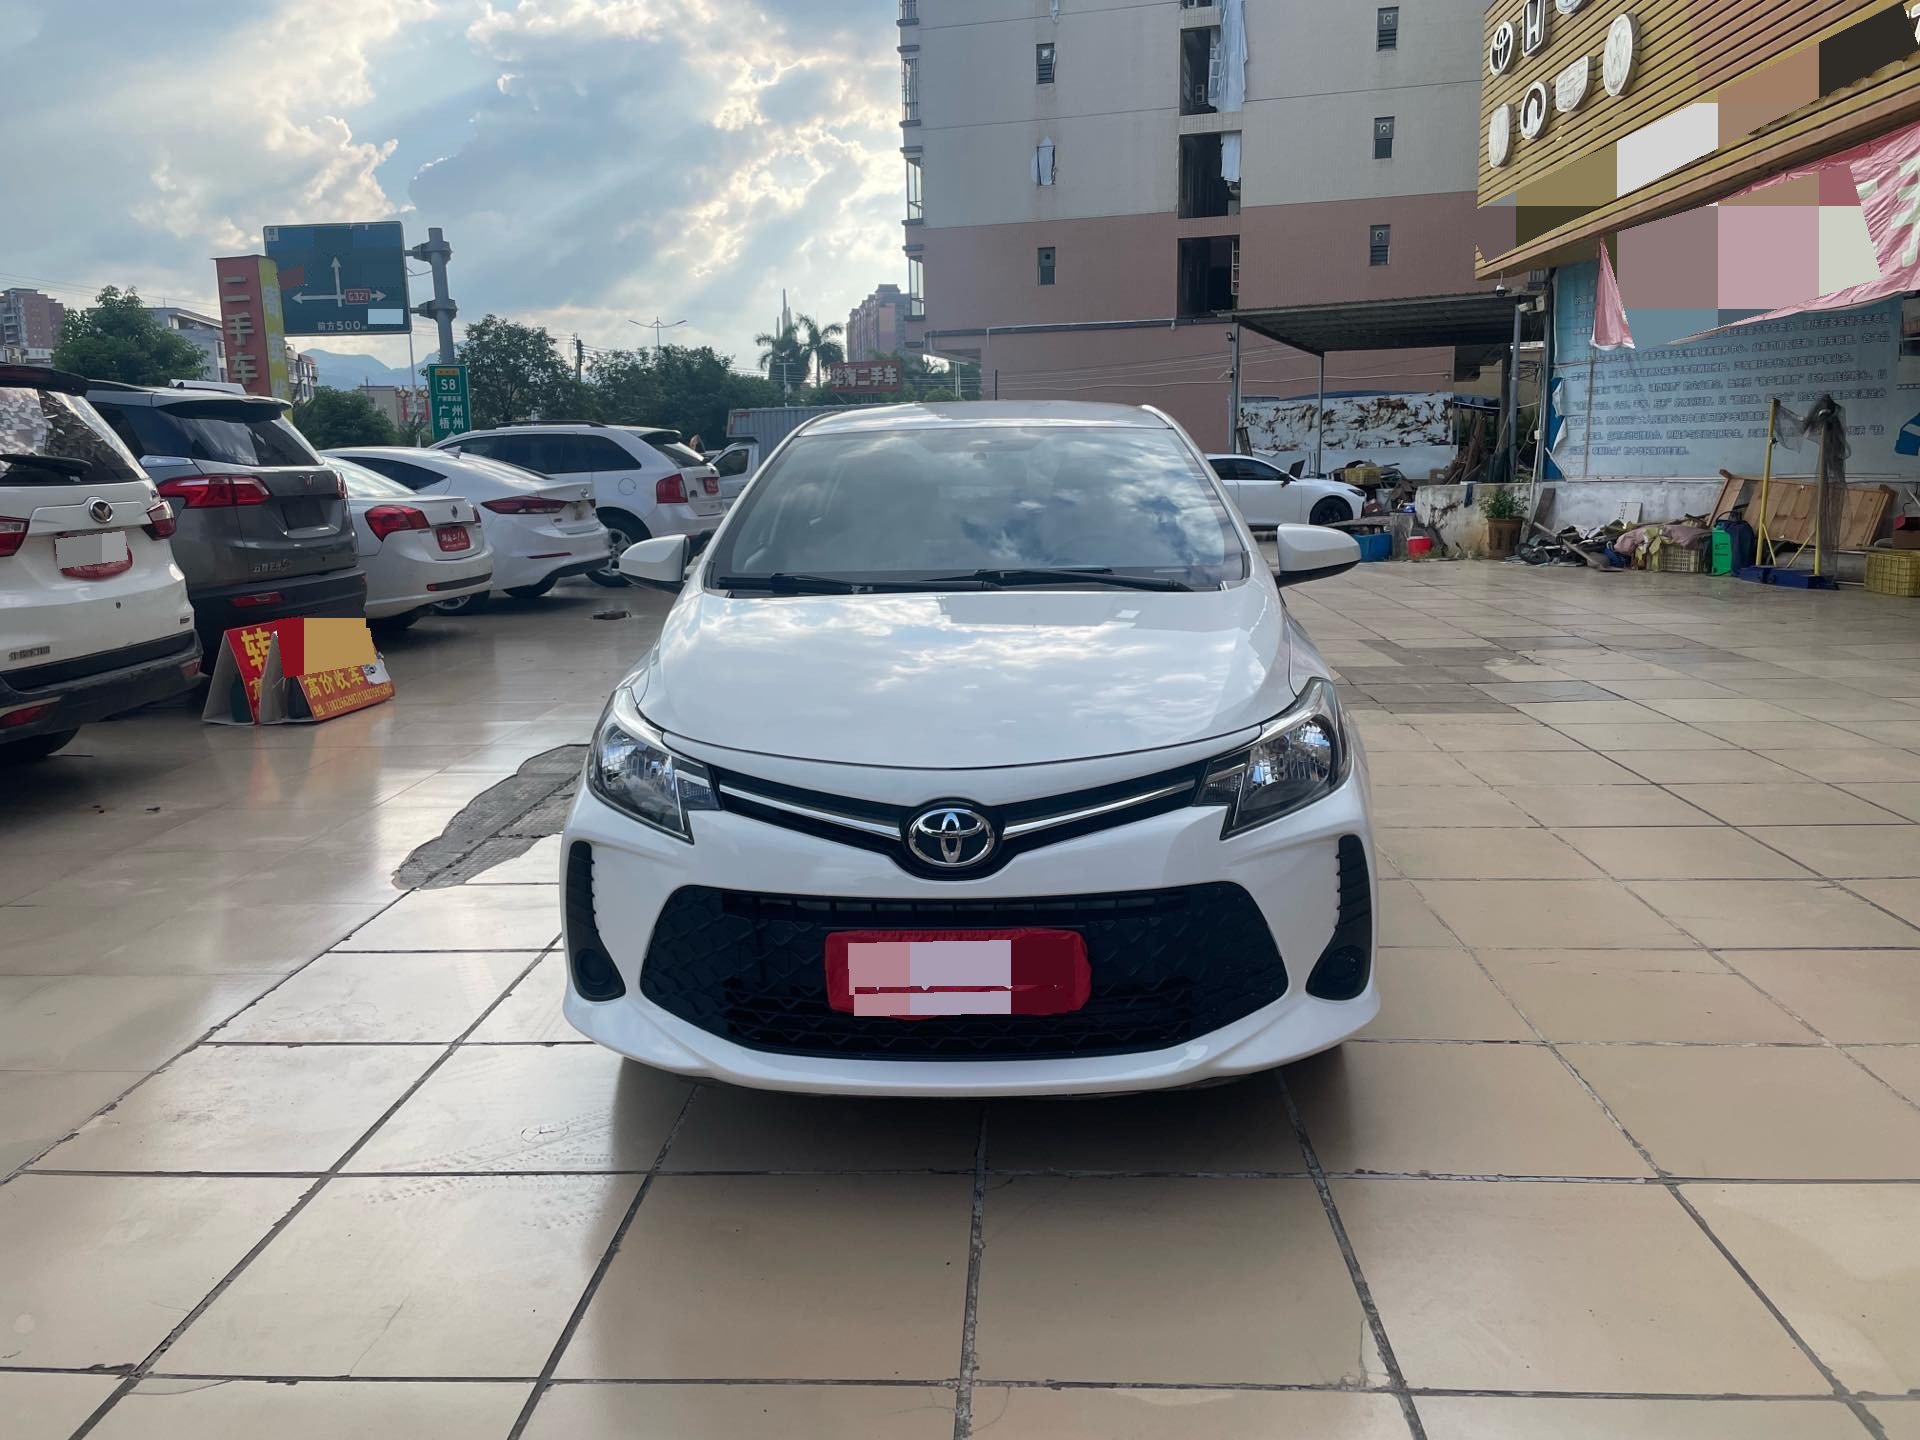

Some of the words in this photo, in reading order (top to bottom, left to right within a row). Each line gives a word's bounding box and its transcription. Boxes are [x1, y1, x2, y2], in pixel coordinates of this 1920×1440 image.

[222, 276, 259, 385] 二手车
[441, 379, 456, 390] S8
[439, 405, 463, 417] 广州
